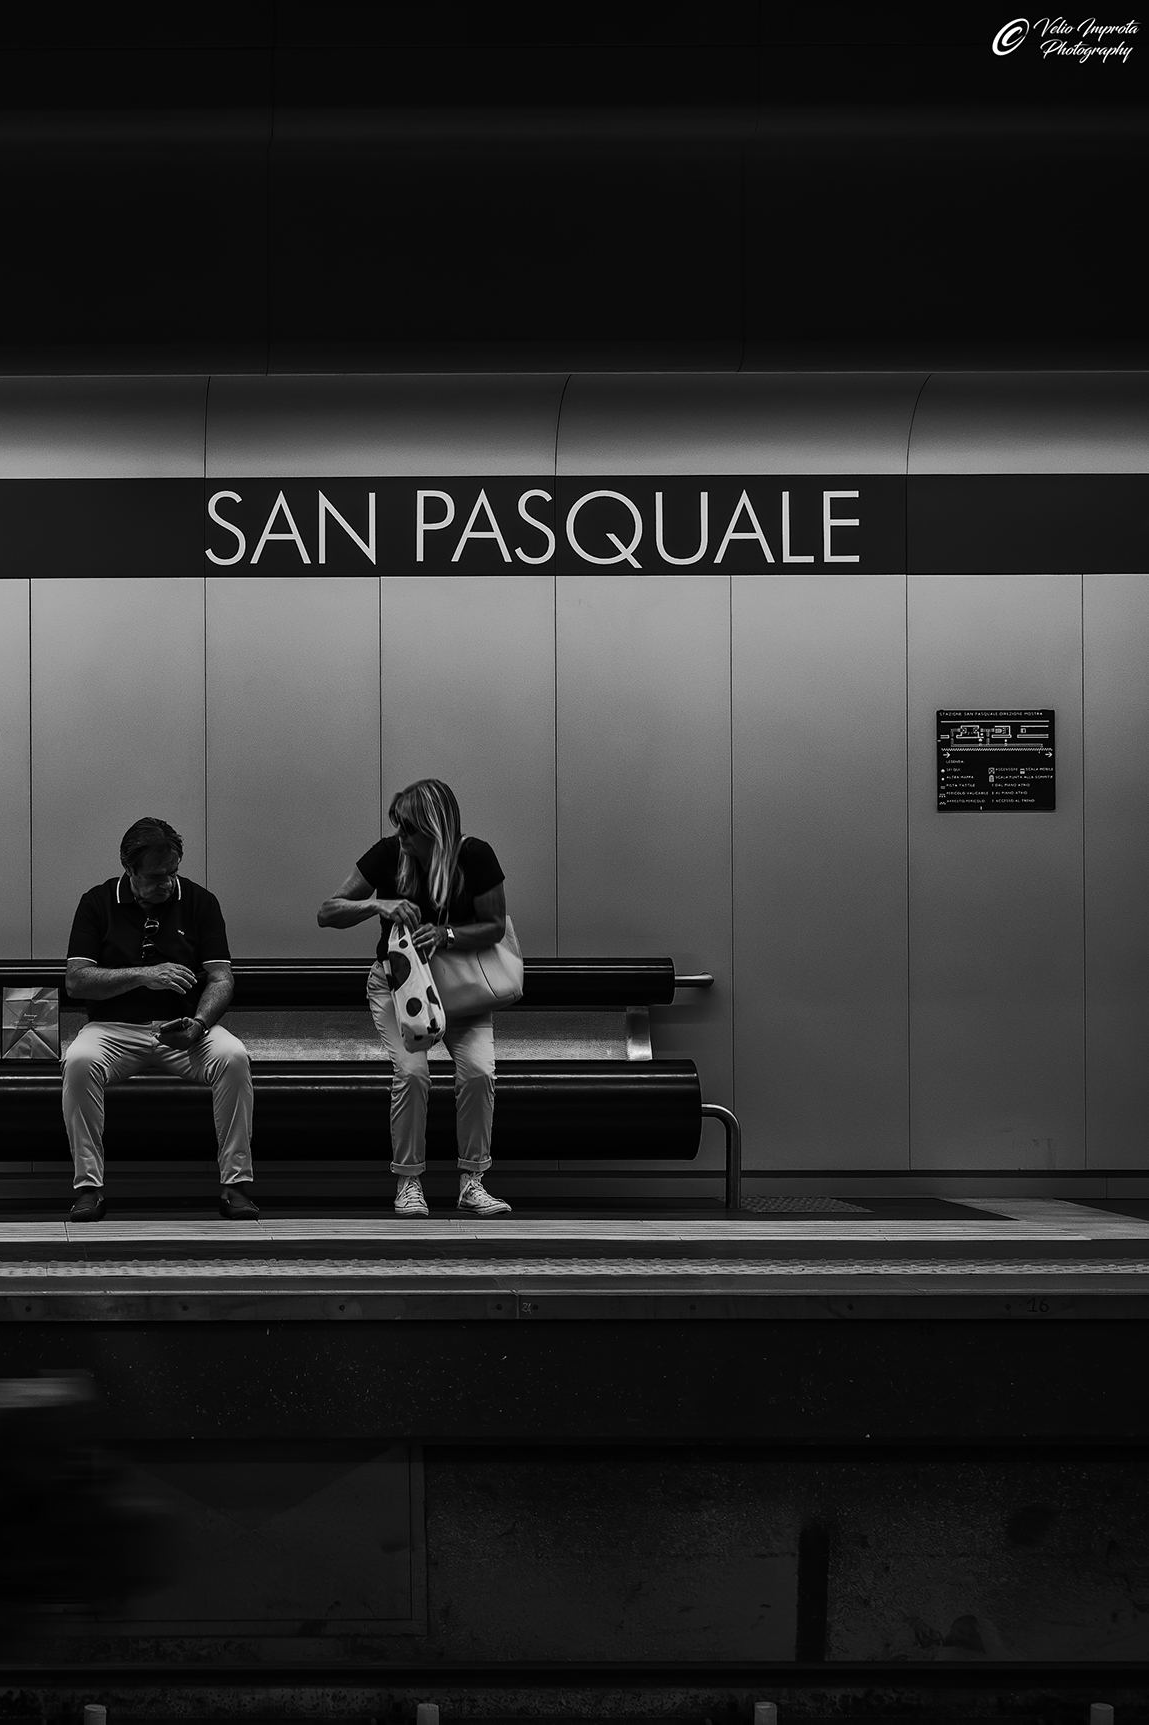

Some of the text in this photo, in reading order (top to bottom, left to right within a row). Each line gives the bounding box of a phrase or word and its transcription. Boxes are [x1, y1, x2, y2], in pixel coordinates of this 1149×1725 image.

[204, 488, 860, 569] SAN PASQUALE
[1026, 1296, 1049, 1313] 16
